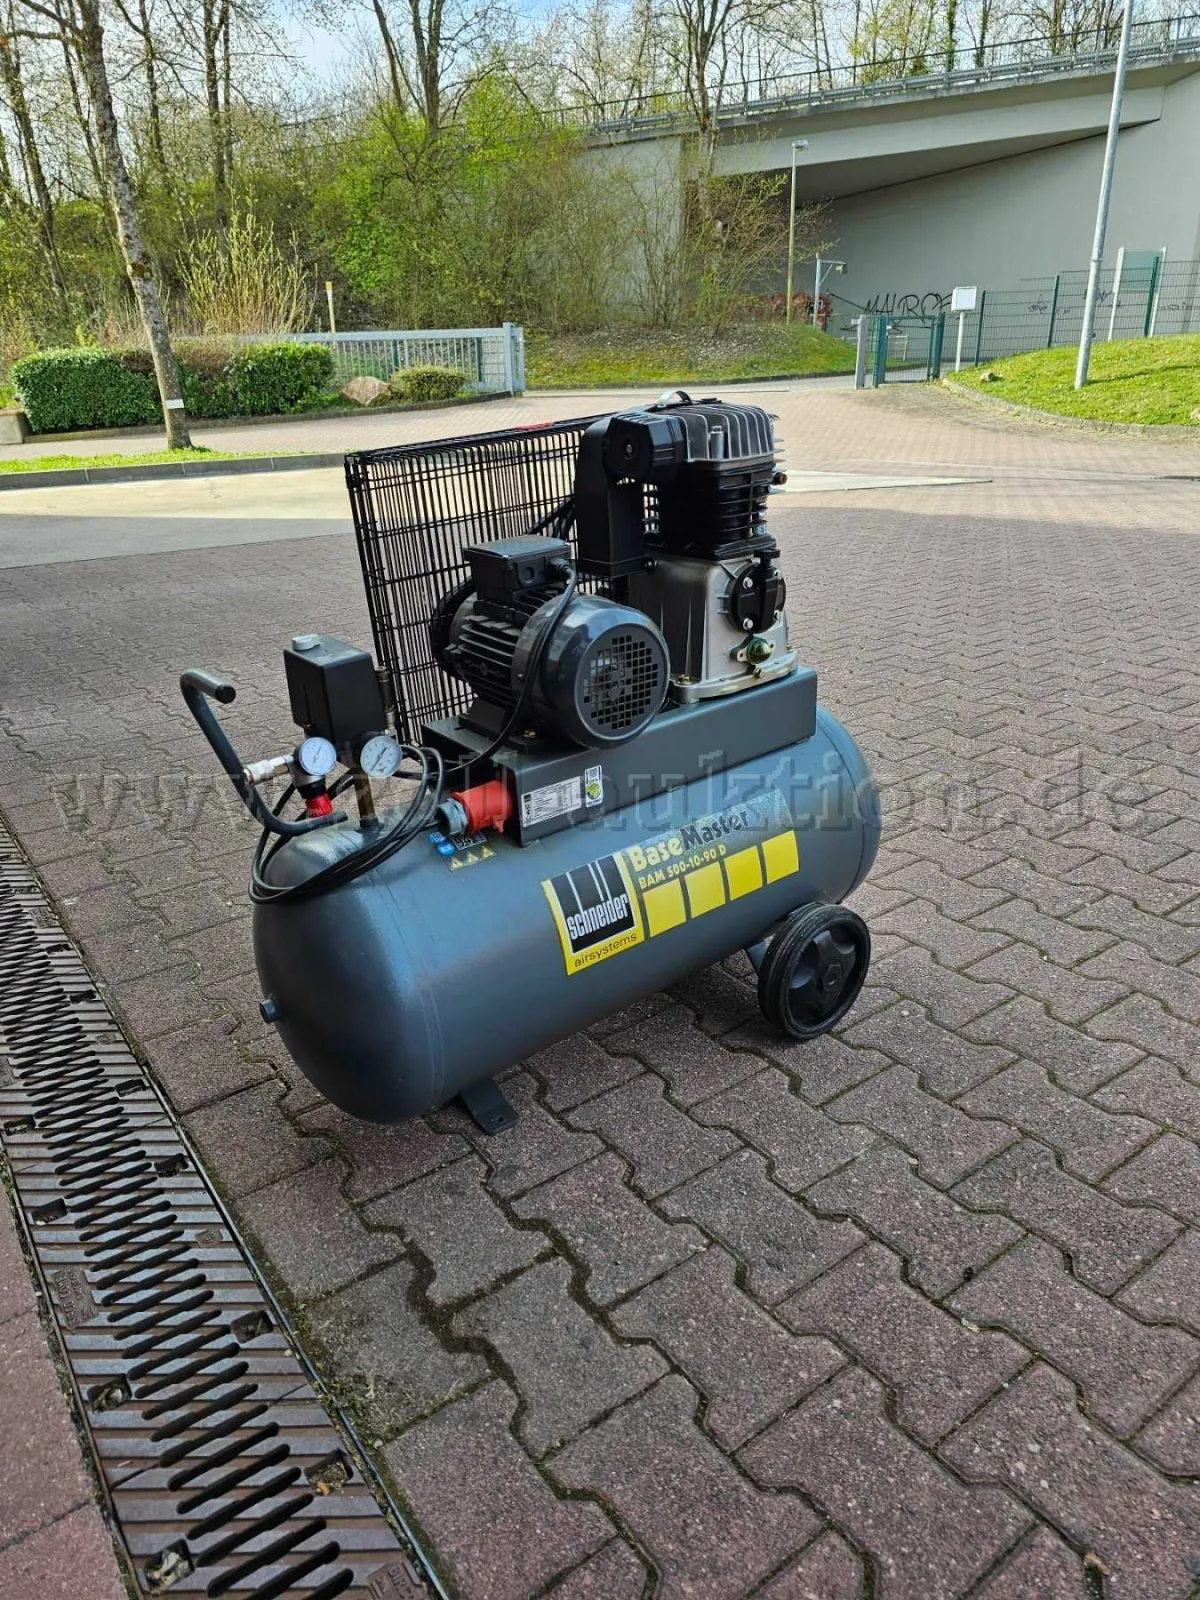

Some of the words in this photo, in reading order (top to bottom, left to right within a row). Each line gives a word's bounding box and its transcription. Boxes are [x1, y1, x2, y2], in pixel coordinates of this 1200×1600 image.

[627, 810, 749, 872] BaseMaster
[638, 867, 666, 889] BAM
[667, 848, 717, 878] 500-10-90
[718, 844, 727, 857] D
[566, 884, 630, 940] schneider
[574, 933, 638, 968] airsystems
